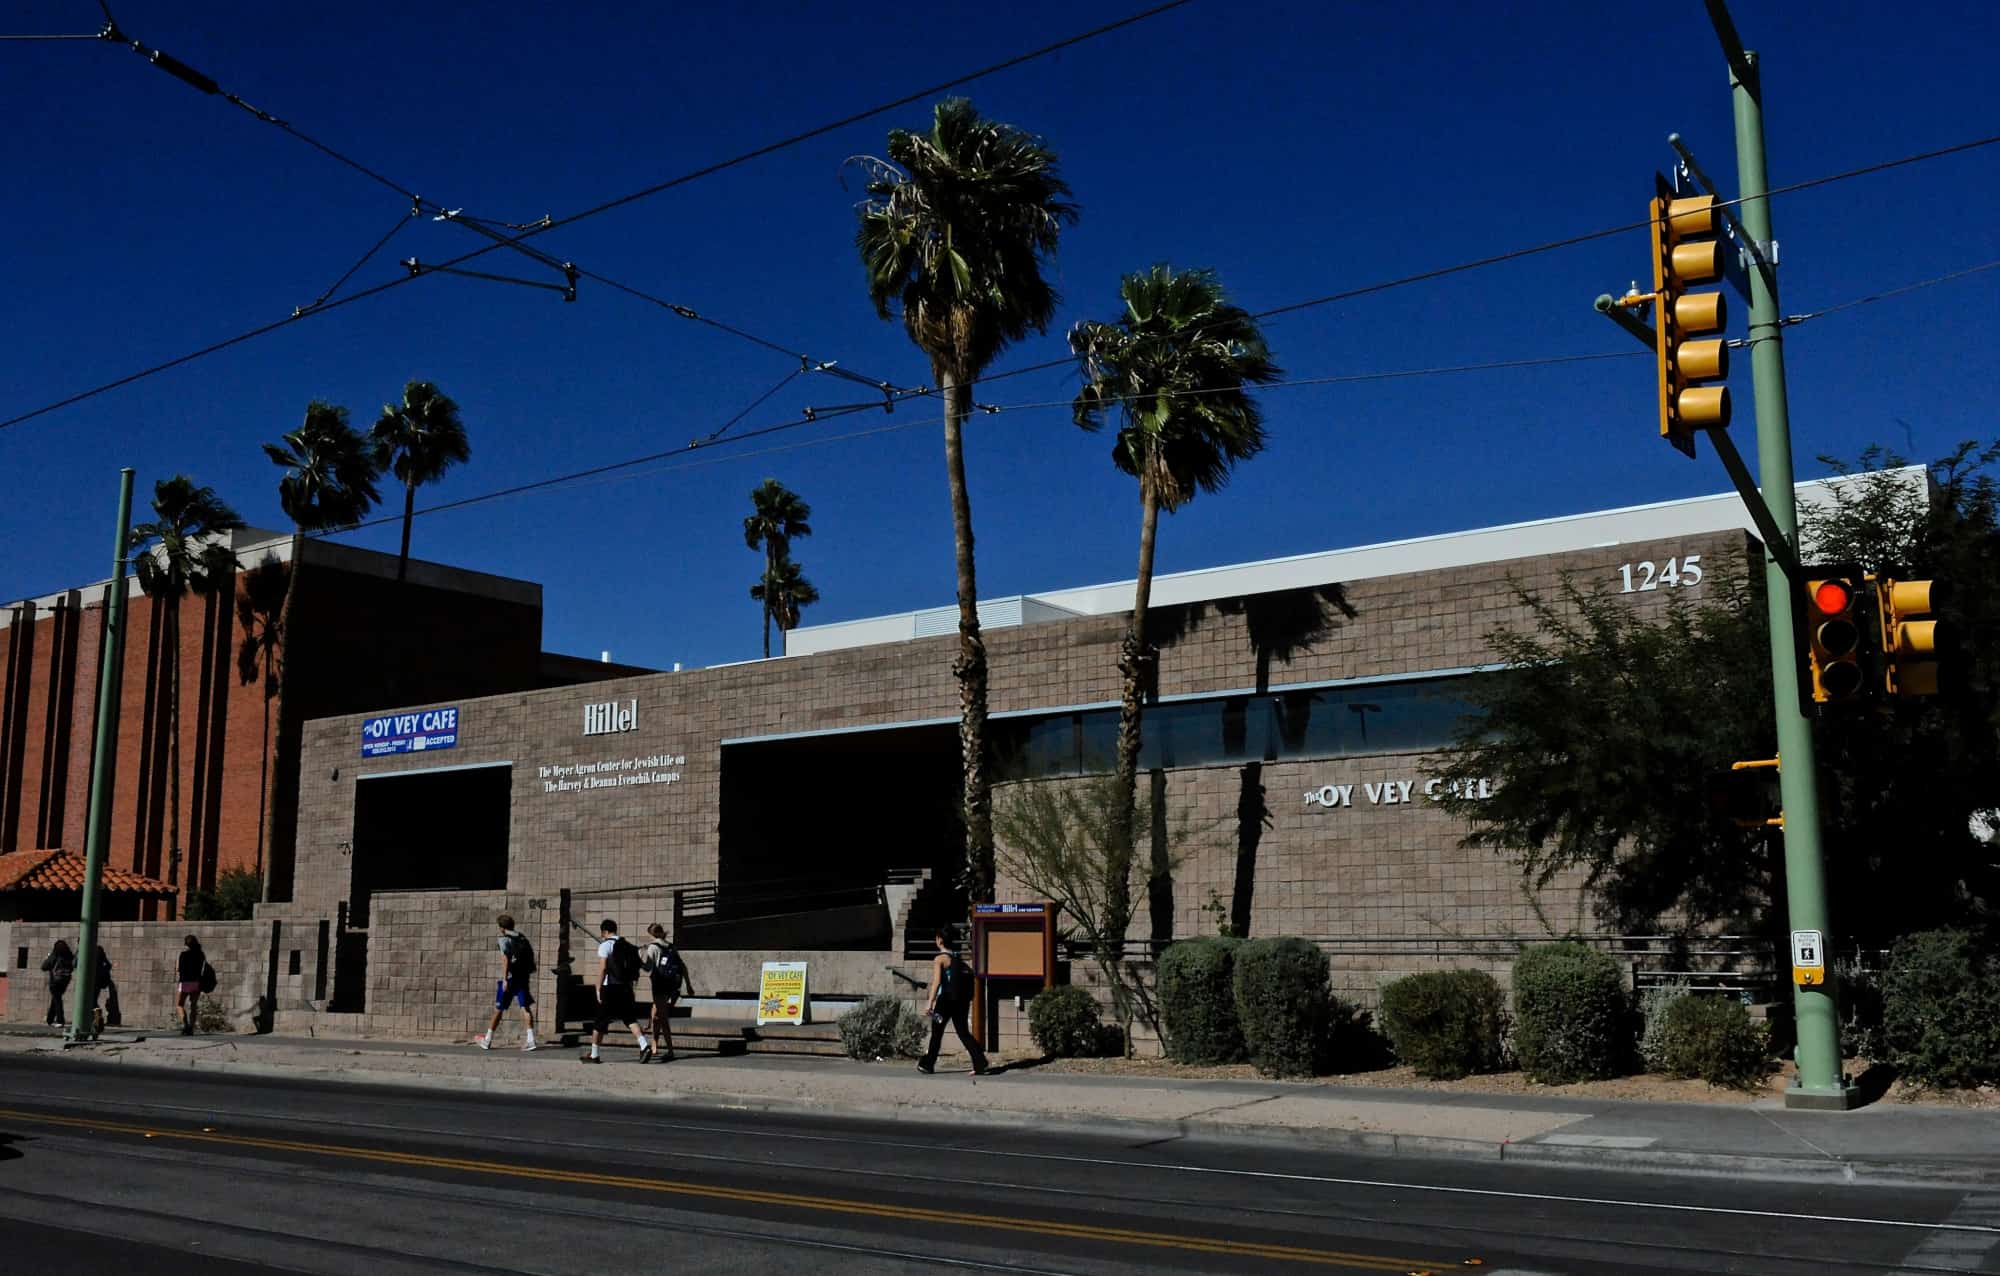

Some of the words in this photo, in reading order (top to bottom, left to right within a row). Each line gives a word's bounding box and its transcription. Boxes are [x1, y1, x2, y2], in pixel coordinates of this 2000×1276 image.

[1617, 555, 1702, 593] 1245
[372, 718, 391, 737] OY
[395, 714, 420, 735] VEY
[422, 710, 456, 731] CAFE
[584, 699, 639, 735] Hillel
[426, 735, 455, 745] ACCEPTED
[539, 766, 552, 778] The
[553, 765, 574, 778] Meyer
[575, 763, 596, 776] Agron
[597, 761, 620, 772] Center
[621, 758, 632, 770] for
[633, 757, 659, 769] Jewish
[660, 754, 674, 766] Life
[675, 756, 685, 765] on
[545, 781, 558, 792] The
[558, 779, 582, 792] Harvey
[584, 777, 590, 788] &
[591, 777, 617, 788] Deanna
[652, 771, 680, 784] Campus
[1304, 791, 1321, 805] The
[1318, 785, 1353, 808] OY
[1364, 780, 1414, 805] VEY
